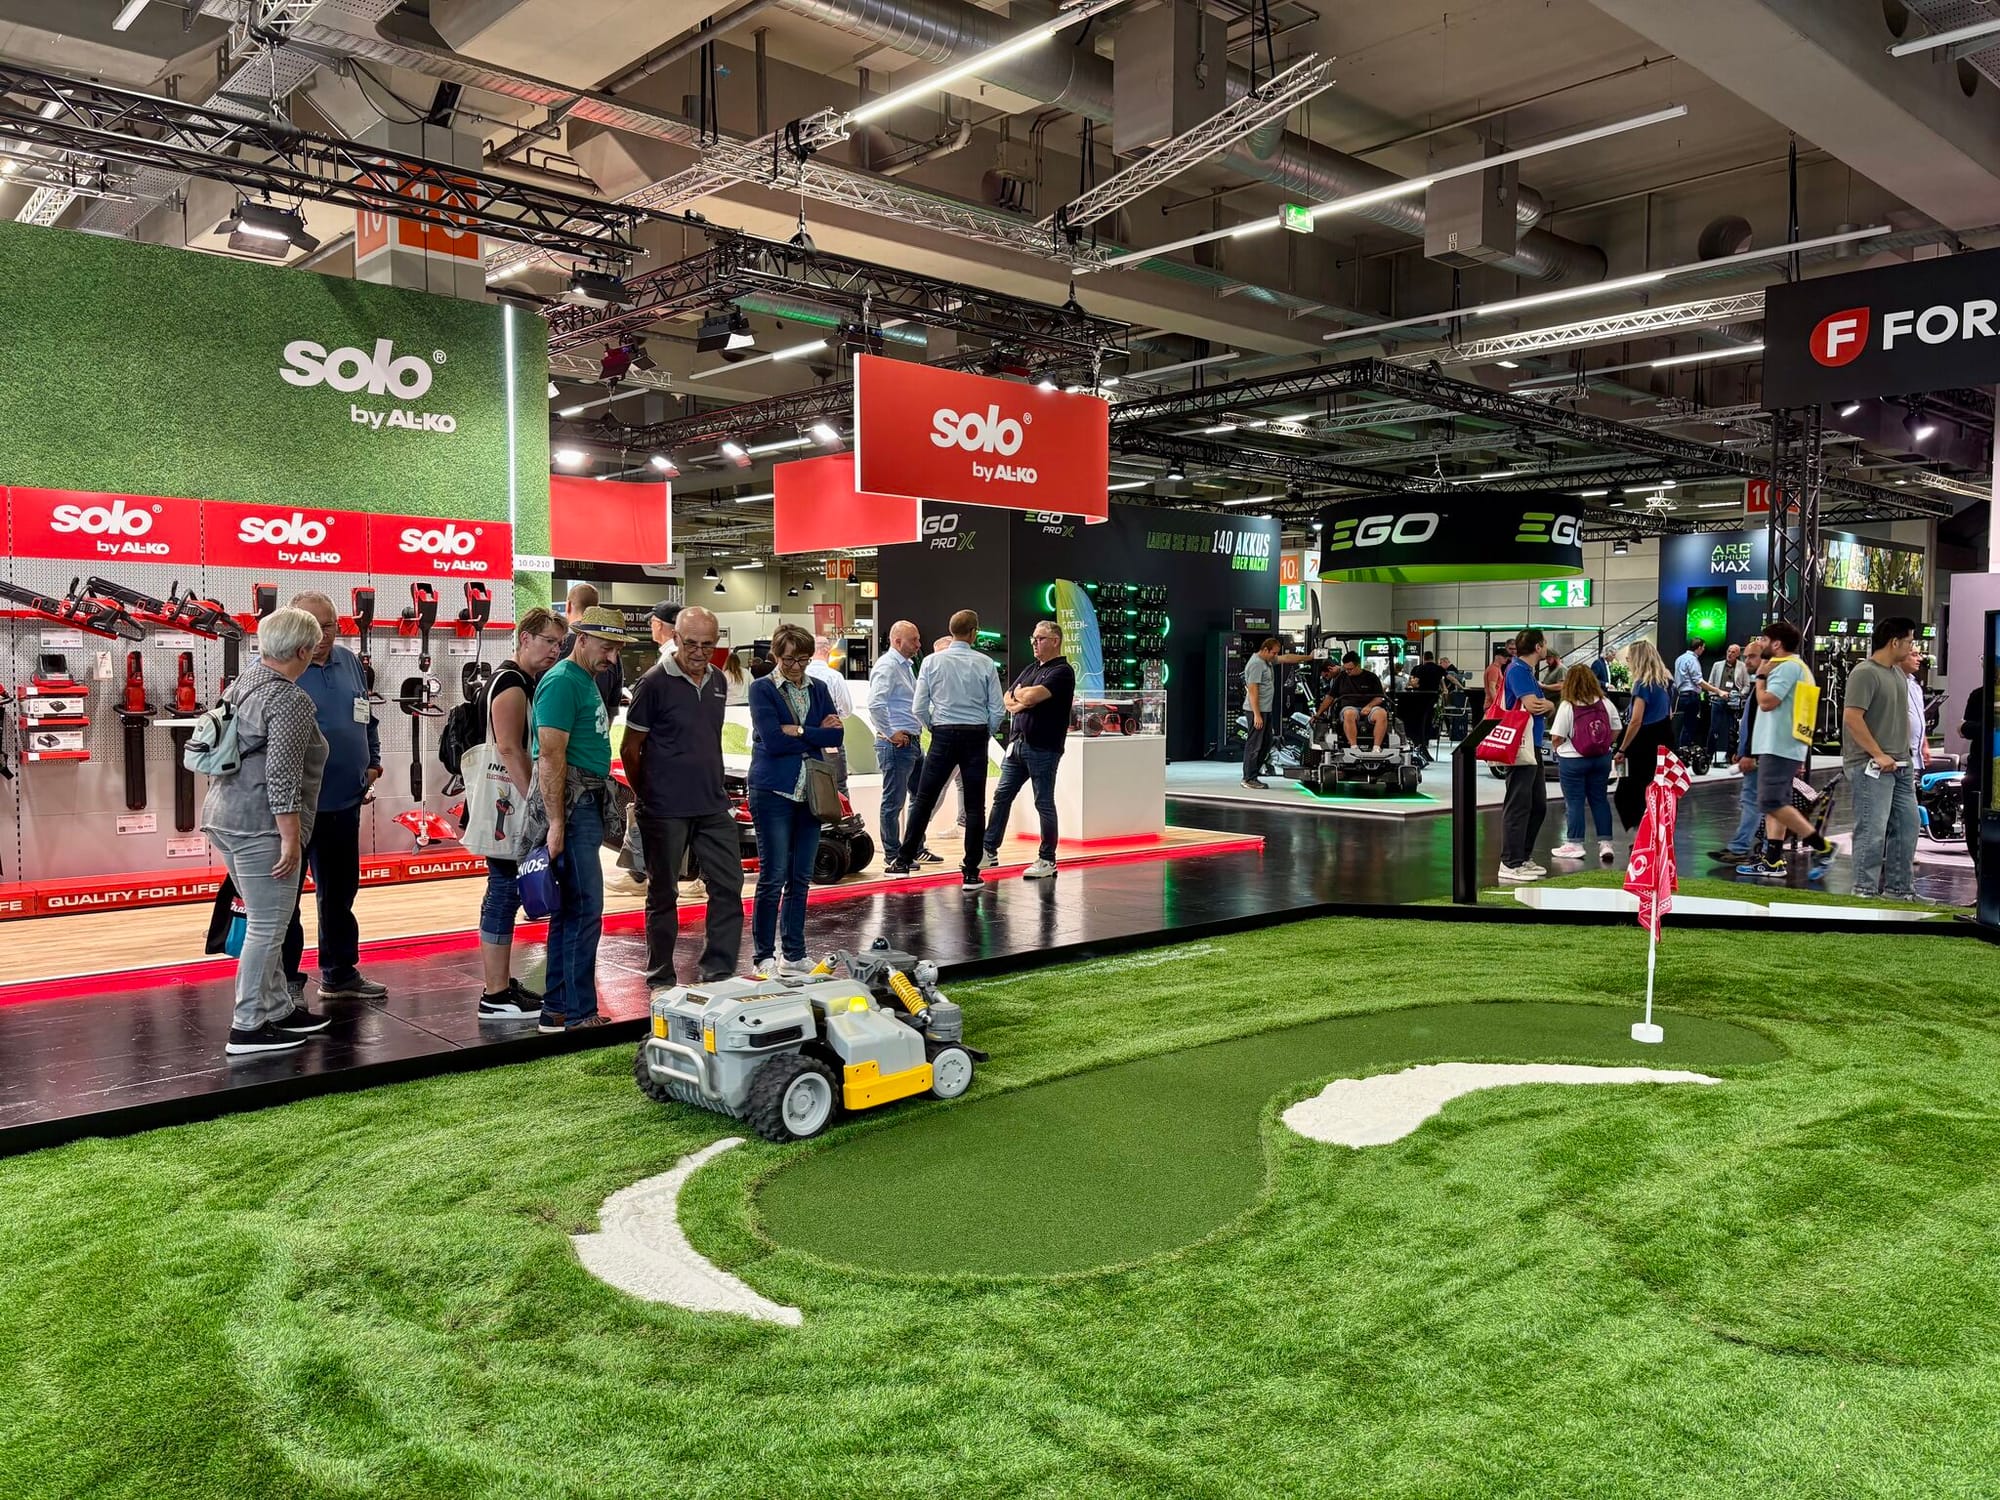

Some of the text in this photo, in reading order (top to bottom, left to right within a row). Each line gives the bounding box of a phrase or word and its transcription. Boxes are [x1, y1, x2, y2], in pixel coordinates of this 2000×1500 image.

[1883, 299, 2000, 350] FOR
[351, 404, 385, 430] by
[972, 461, 994, 482] by
[922, 513, 959, 535] GO
[1042, 526, 1062, 535] PRO
[1330, 511, 1440, 551] EGO
[96, 541, 120, 555] by
[930, 537, 957, 550] PRO
[1211, 529, 1233, 554] 140
[1234, 531, 1271, 558] AKKUS
[1712, 543, 1751, 555] ARC
[278, 550, 298, 564] by
[433, 559, 452, 572] by
[828, 563, 836, 575] 10
[841, 563, 853, 575] 10
[1711, 560, 1751, 574] MAX
[409, 861, 471, 875] QUALITY
[48, 882, 220, 908] QUALITY FOR LIFE
